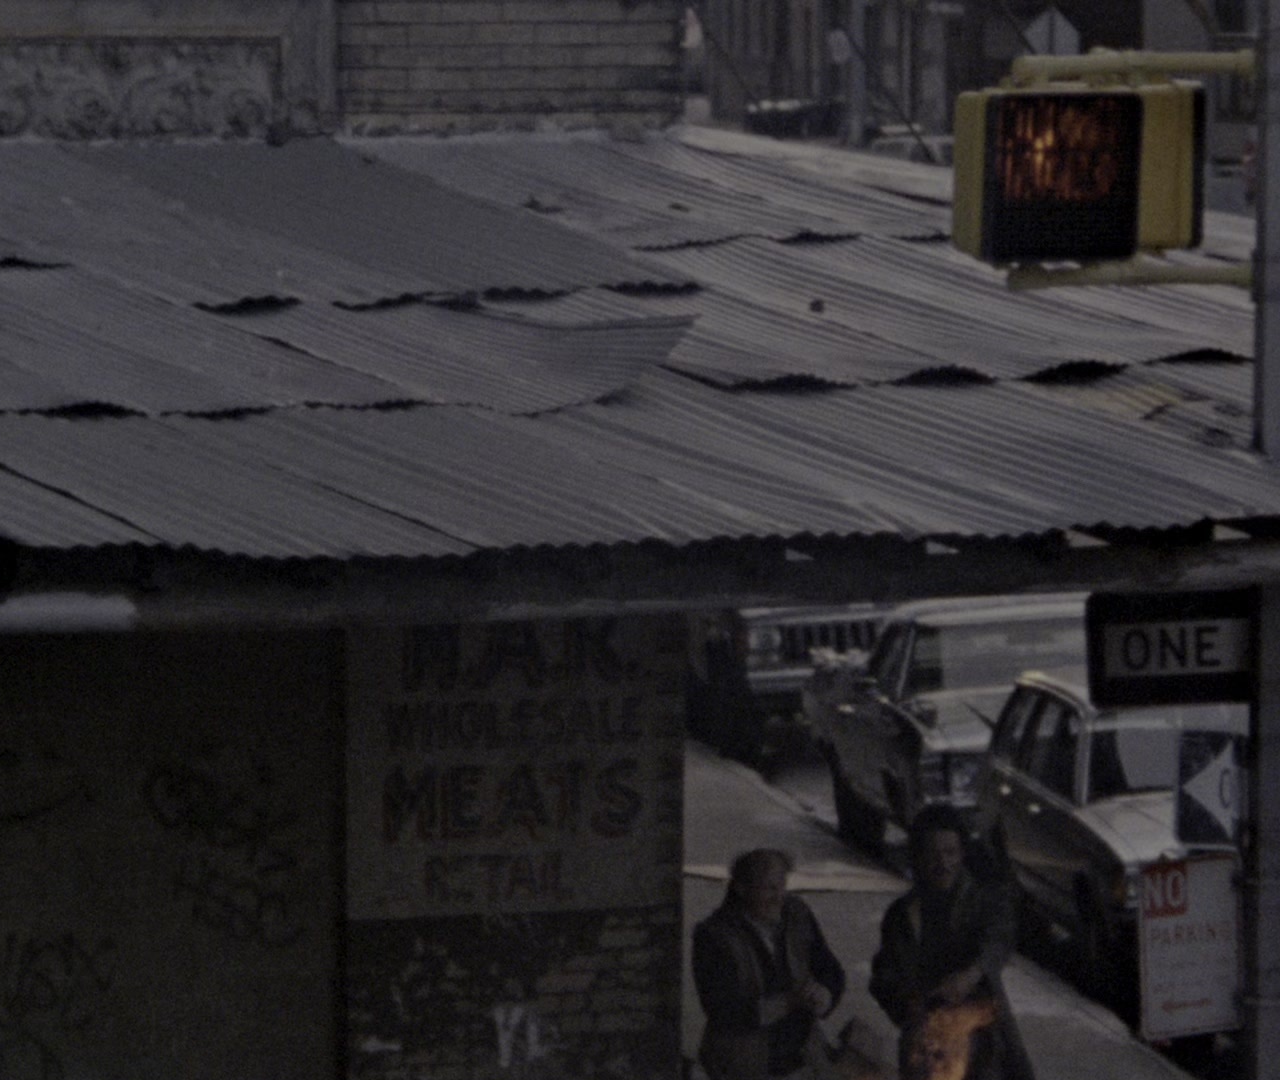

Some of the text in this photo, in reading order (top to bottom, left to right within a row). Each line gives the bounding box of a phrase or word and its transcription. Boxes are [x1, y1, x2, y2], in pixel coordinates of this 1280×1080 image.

[1123, 626, 1221, 671] ONE
[387, 697, 642, 750] WHOLESALE
[382, 759, 644, 843] MEATS
[1144, 870, 1184, 908] NO
[1151, 920, 1232, 946] PARKING
